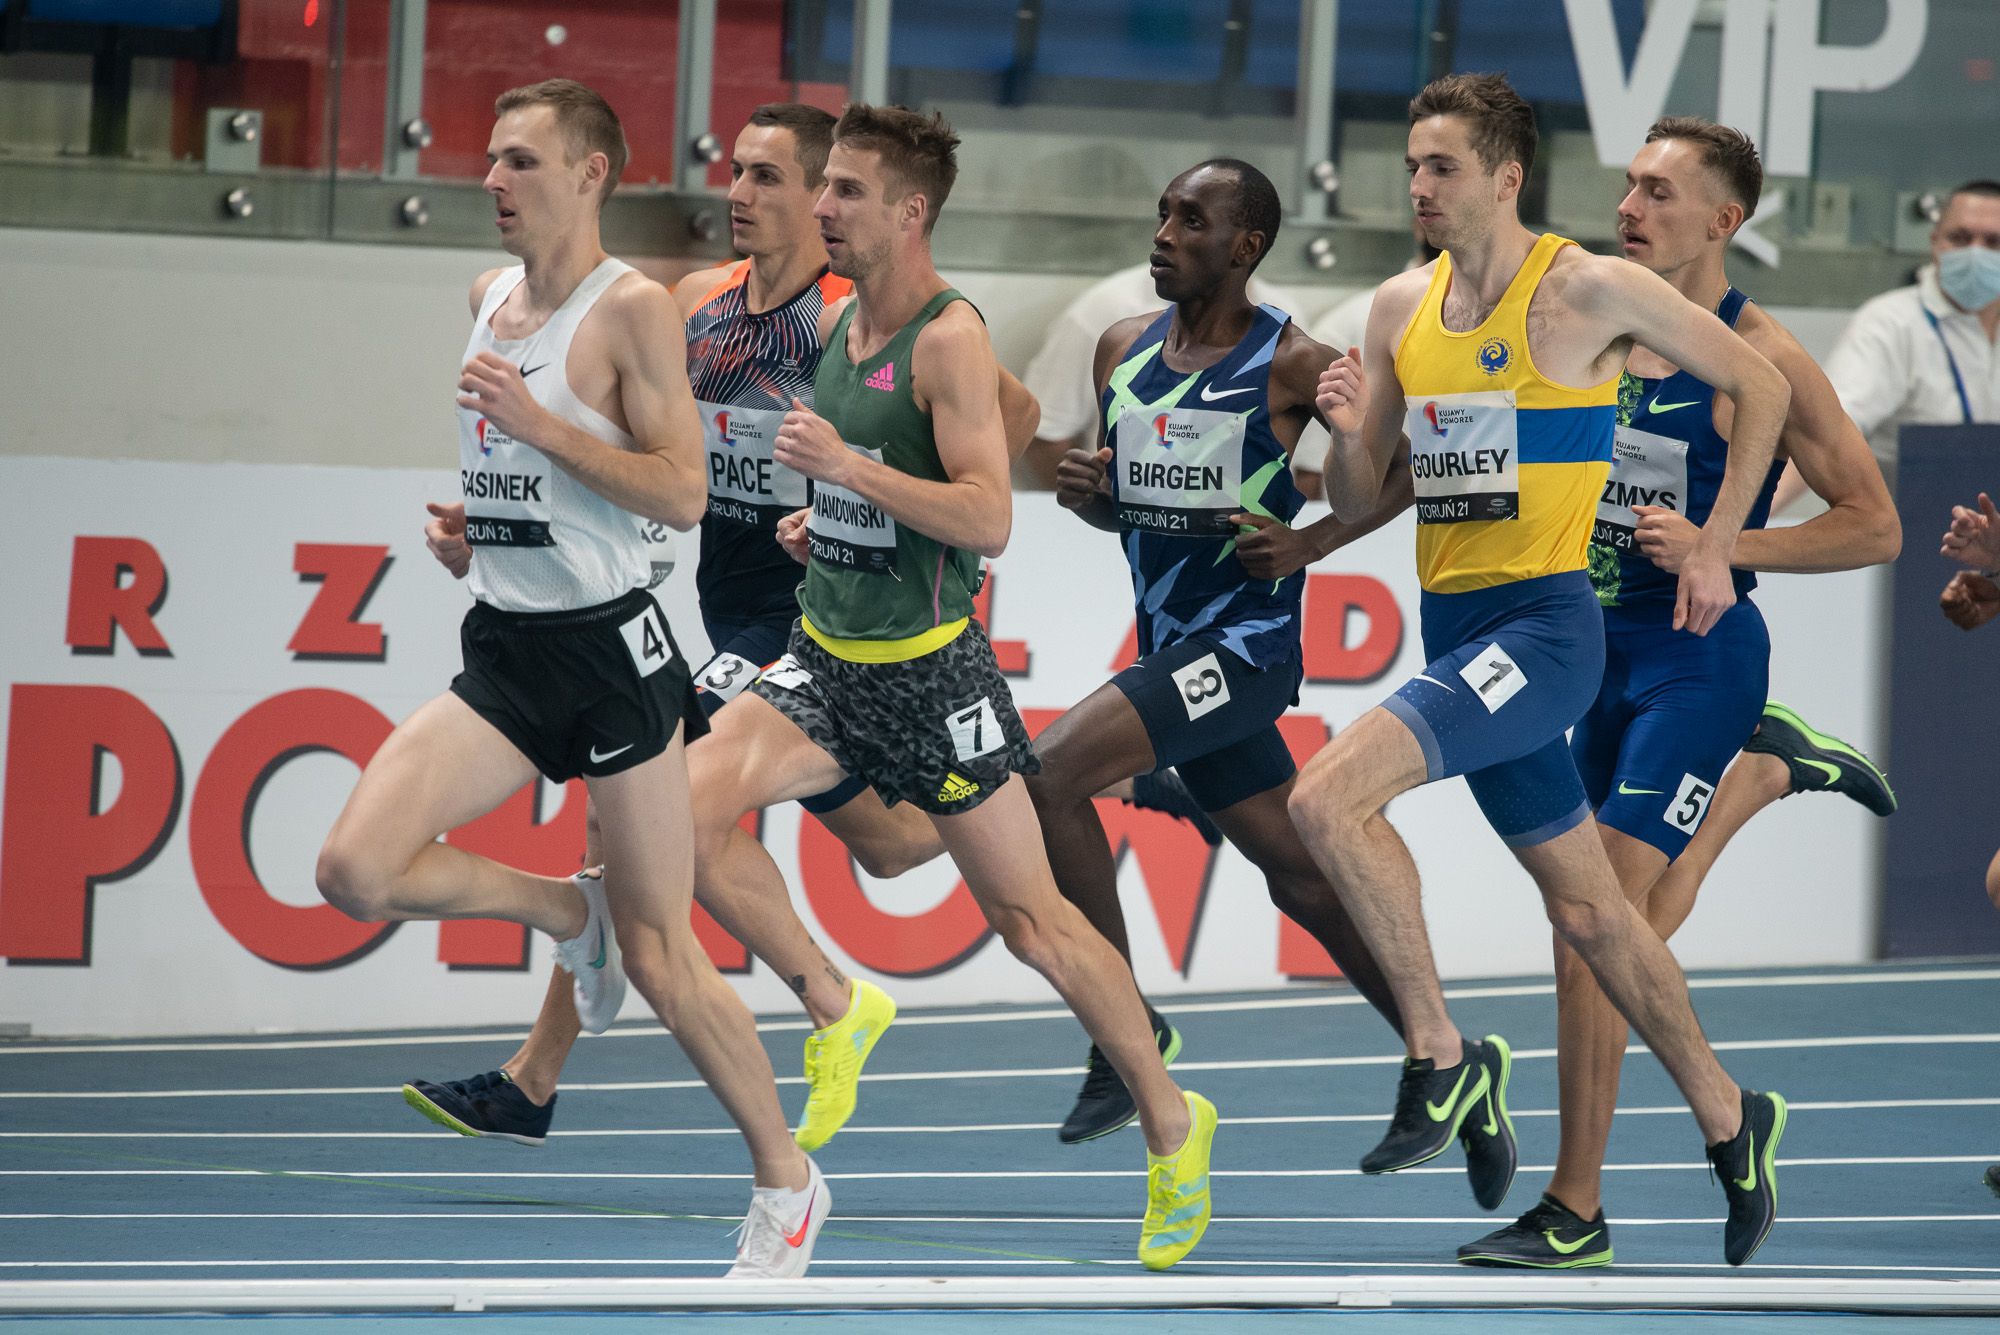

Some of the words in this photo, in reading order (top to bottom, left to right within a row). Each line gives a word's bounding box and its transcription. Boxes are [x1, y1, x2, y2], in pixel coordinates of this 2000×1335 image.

[1562, 0, 1929, 177] VIP
[865, 376, 895, 392] adidas
[1438, 408, 1466, 417] KUJAWY
[1440, 415, 1474, 425] POMORZE
[729, 428, 763, 439] POMORZE
[730, 421, 756, 431] KUJAWY
[1167, 430, 1200, 440] POMORZE
[1168, 423, 1194, 431] KUJAWY
[1615, 440, 1642, 452] KUJAWY
[1615, 449, 1647, 462] POMORZE
[709, 451, 773, 495] PACE
[1412, 448, 1510, 479] GOURLEY
[1129, 460, 1223, 491] BIRGEN
[1600, 479, 1677, 512] ZMYS
[745, 508, 759, 525] 21
[1419, 498, 1455, 519] TORUŃ
[1457, 501, 1469, 517] 21
[466, 520, 497, 541] RUŃ
[498, 525, 513, 541] 21
[1125, 510, 1167, 529] TORUŃ
[1169, 515, 1188, 530] 21
[1615, 532, 1632, 549] 21
[842, 548, 855, 565] 21
[642, 615, 665, 661] 4
[705, 658, 744, 690] 3
[1478, 660, 1514, 696] 1
[1184, 668, 1223, 705] 8
[956, 705, 984, 754] 7
[937, 781, 980, 803] adidas
[1676, 783, 1710, 827] 5
